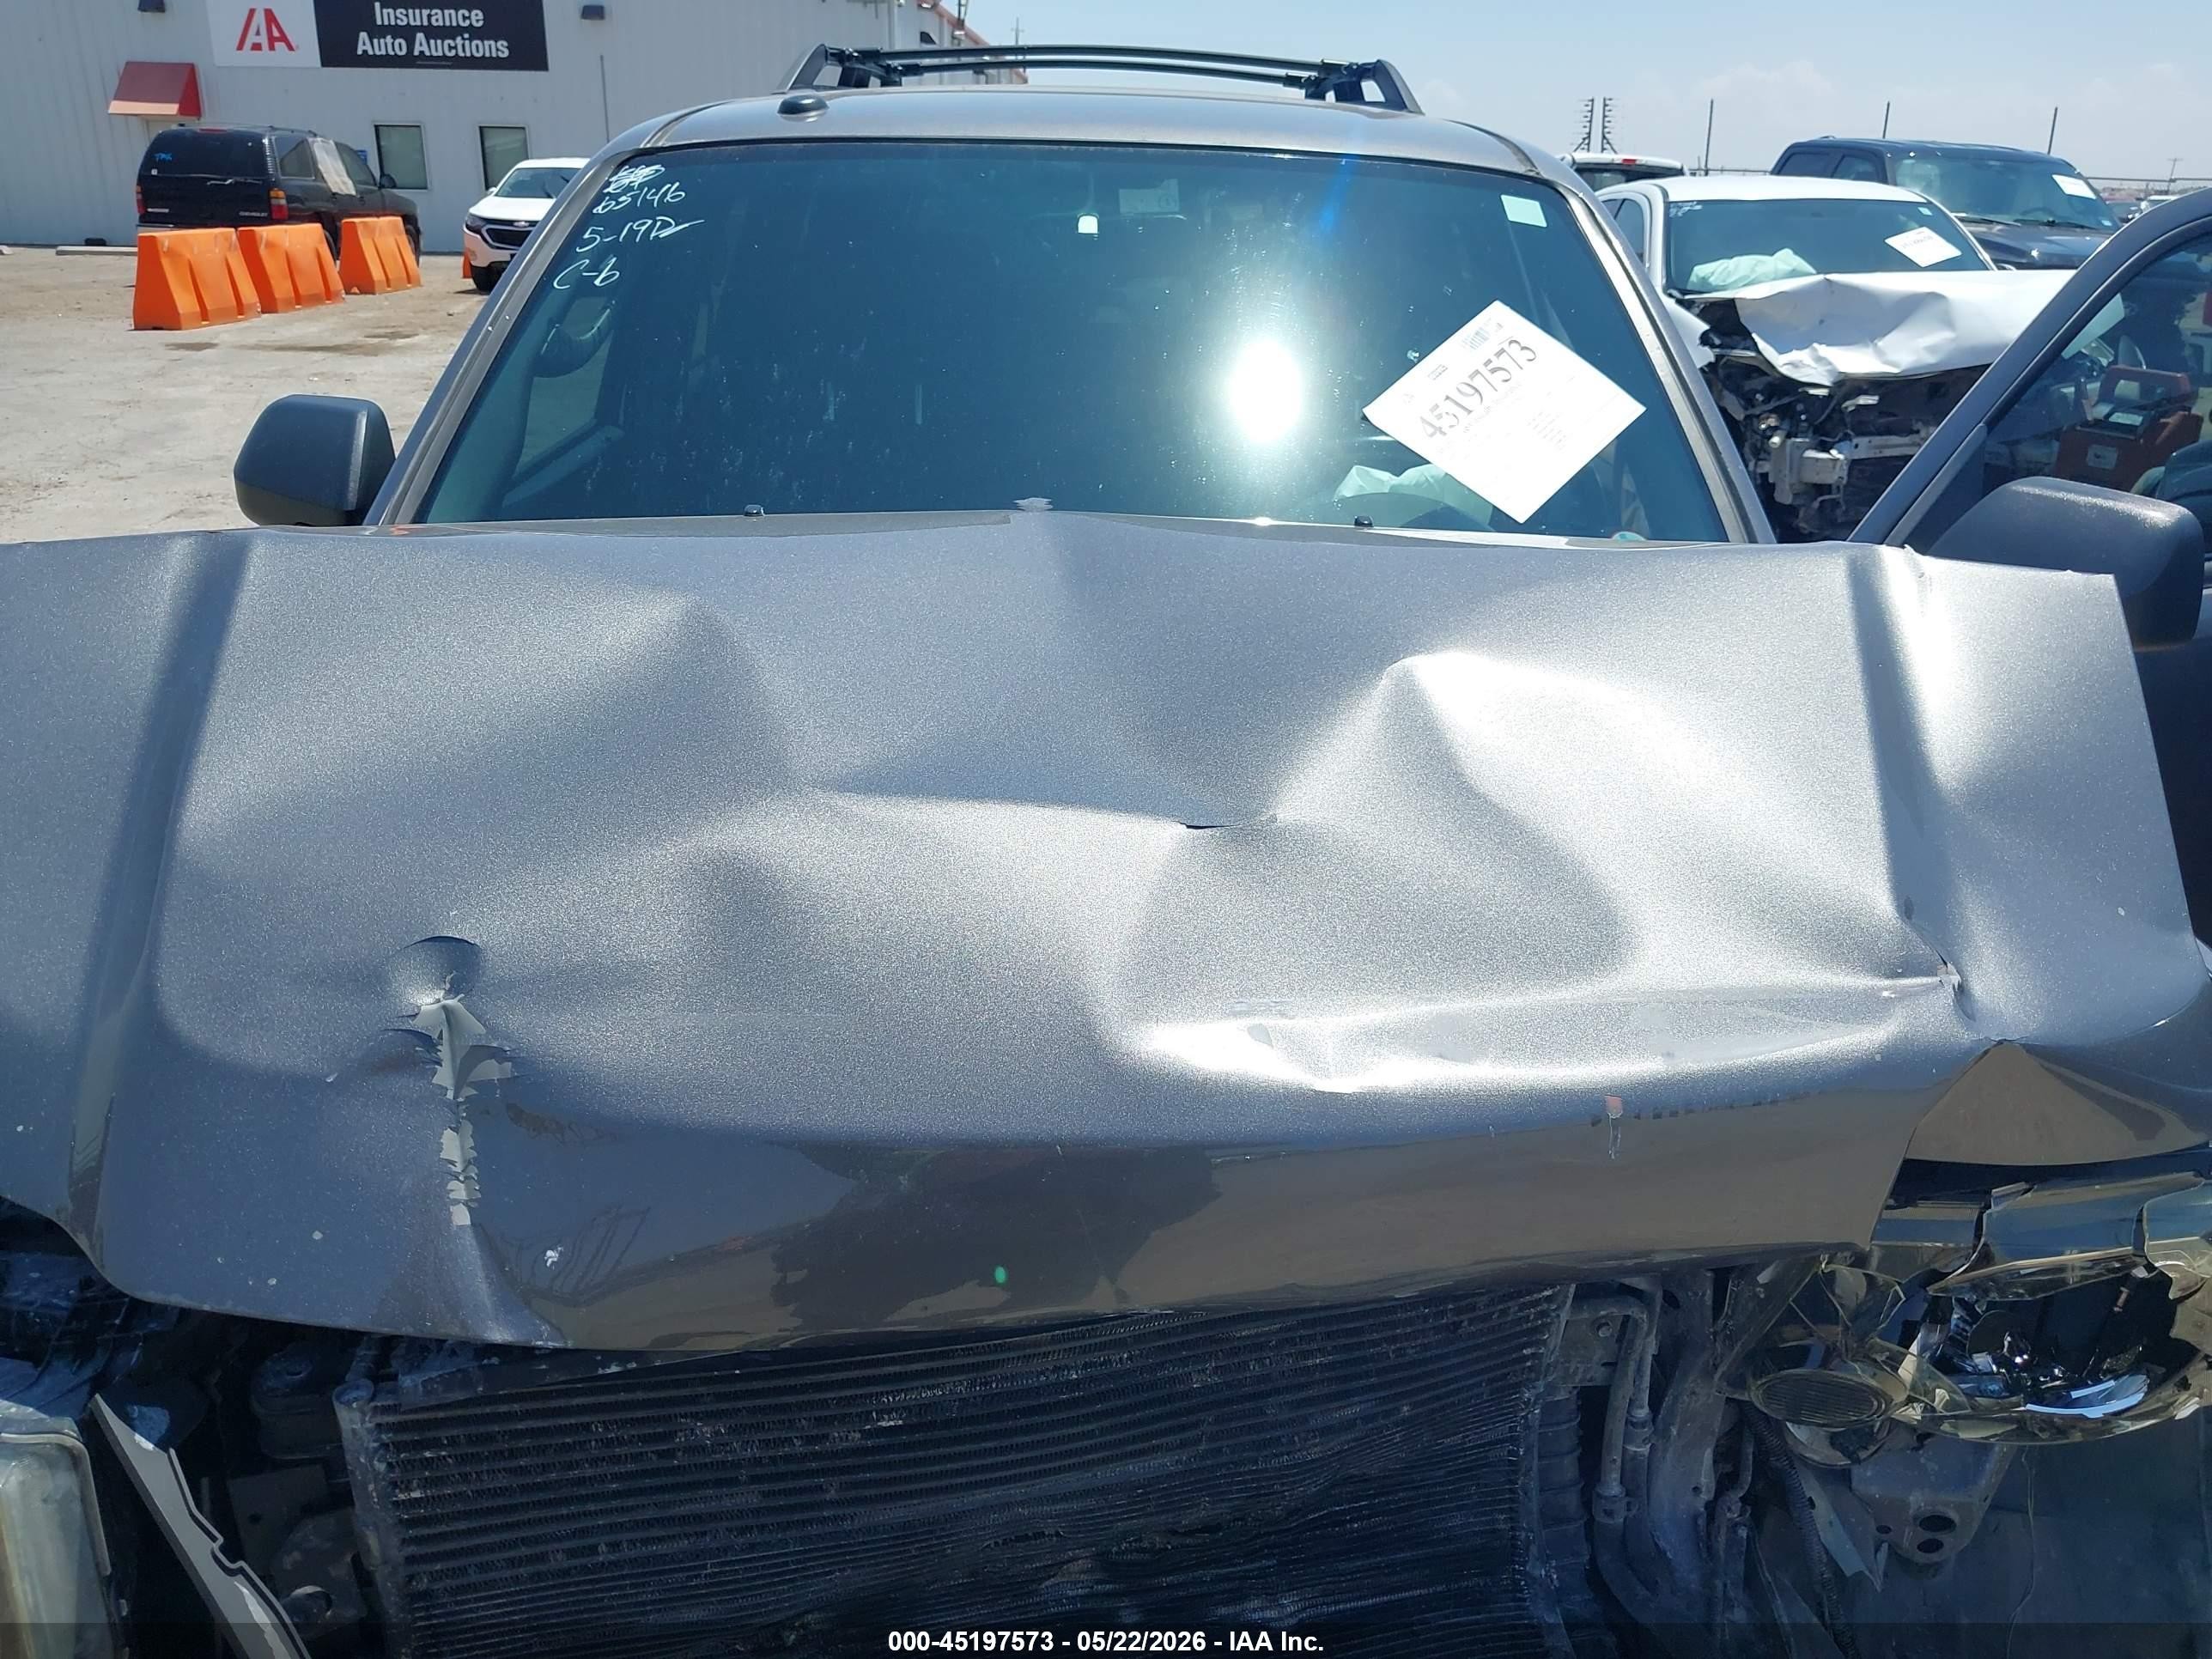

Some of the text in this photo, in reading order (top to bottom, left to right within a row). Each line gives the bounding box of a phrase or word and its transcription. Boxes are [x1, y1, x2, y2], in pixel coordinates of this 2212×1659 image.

[374, 2, 484, 27] Insurance
[356, 32, 509, 58] Auto Auctions
[1419, 336, 1538, 439] 45197573
